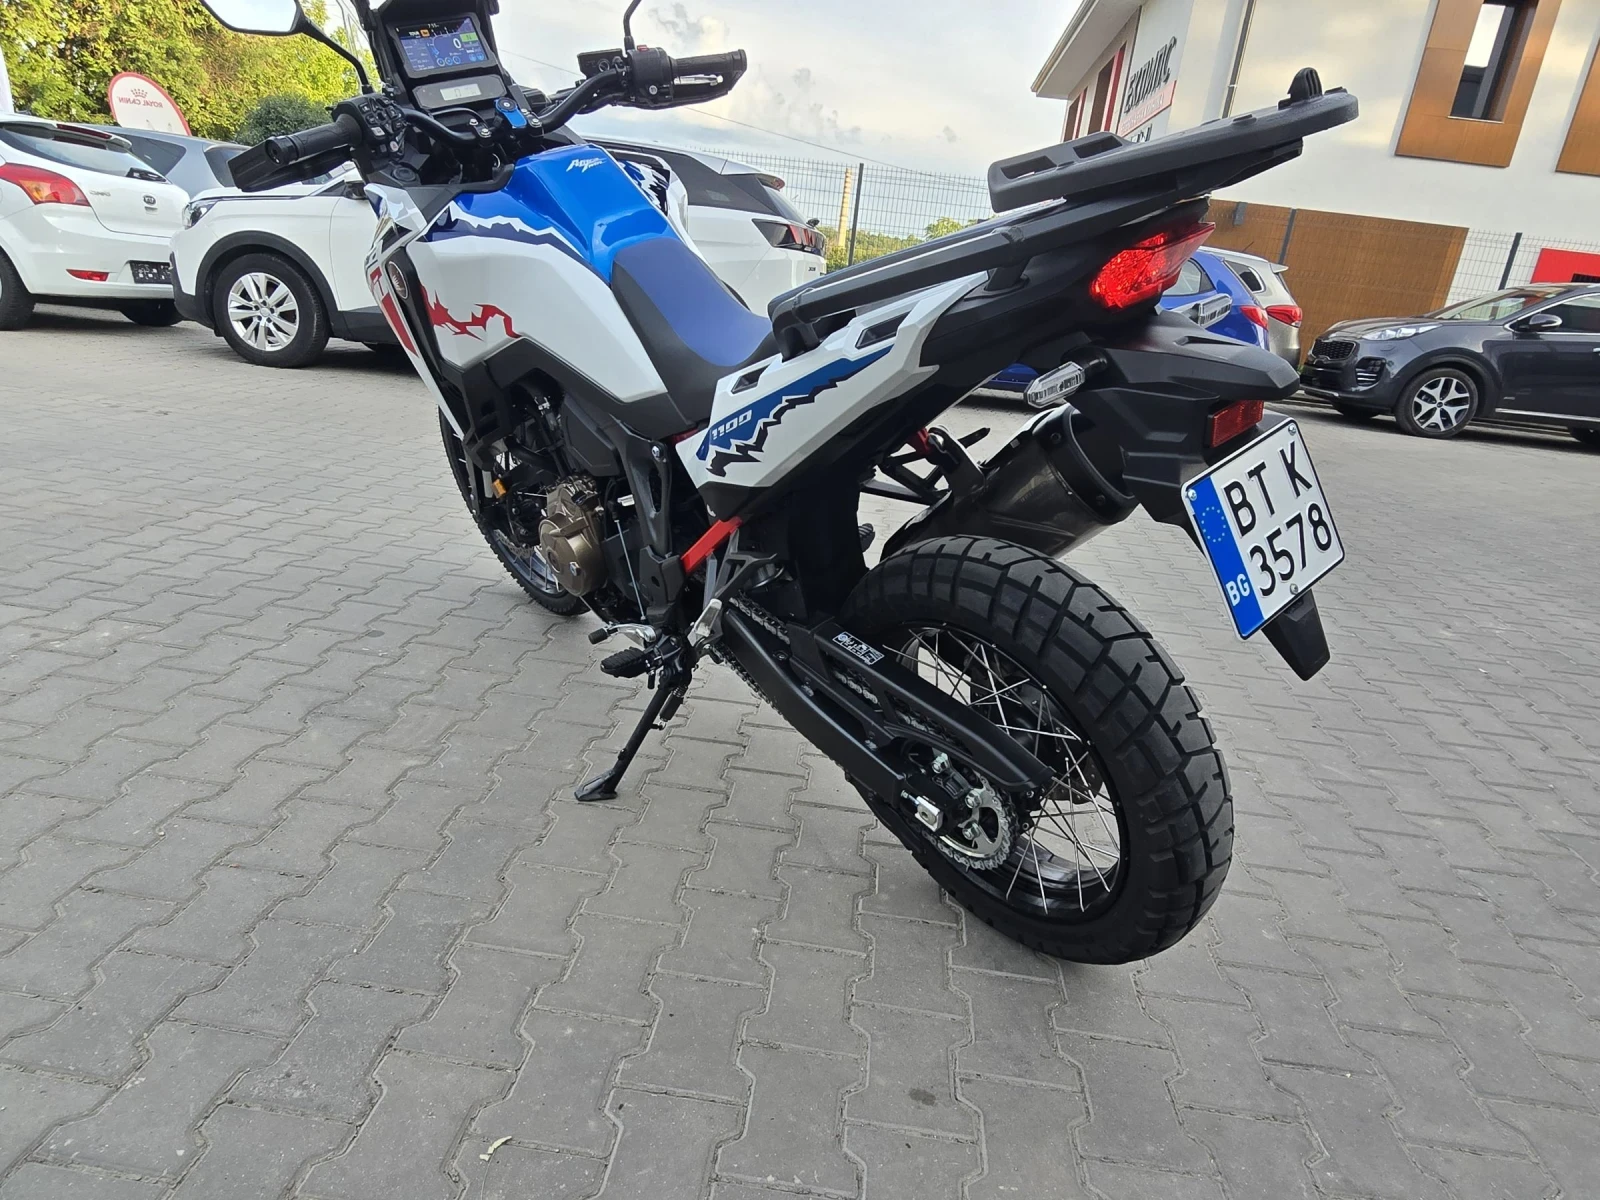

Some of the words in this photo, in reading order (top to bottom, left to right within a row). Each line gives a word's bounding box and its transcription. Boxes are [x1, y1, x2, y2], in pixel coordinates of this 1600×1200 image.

[711, 409, 753, 440] 1100
[1249, 502, 1332, 597] 3578
[1225, 573, 1250, 606] BG
